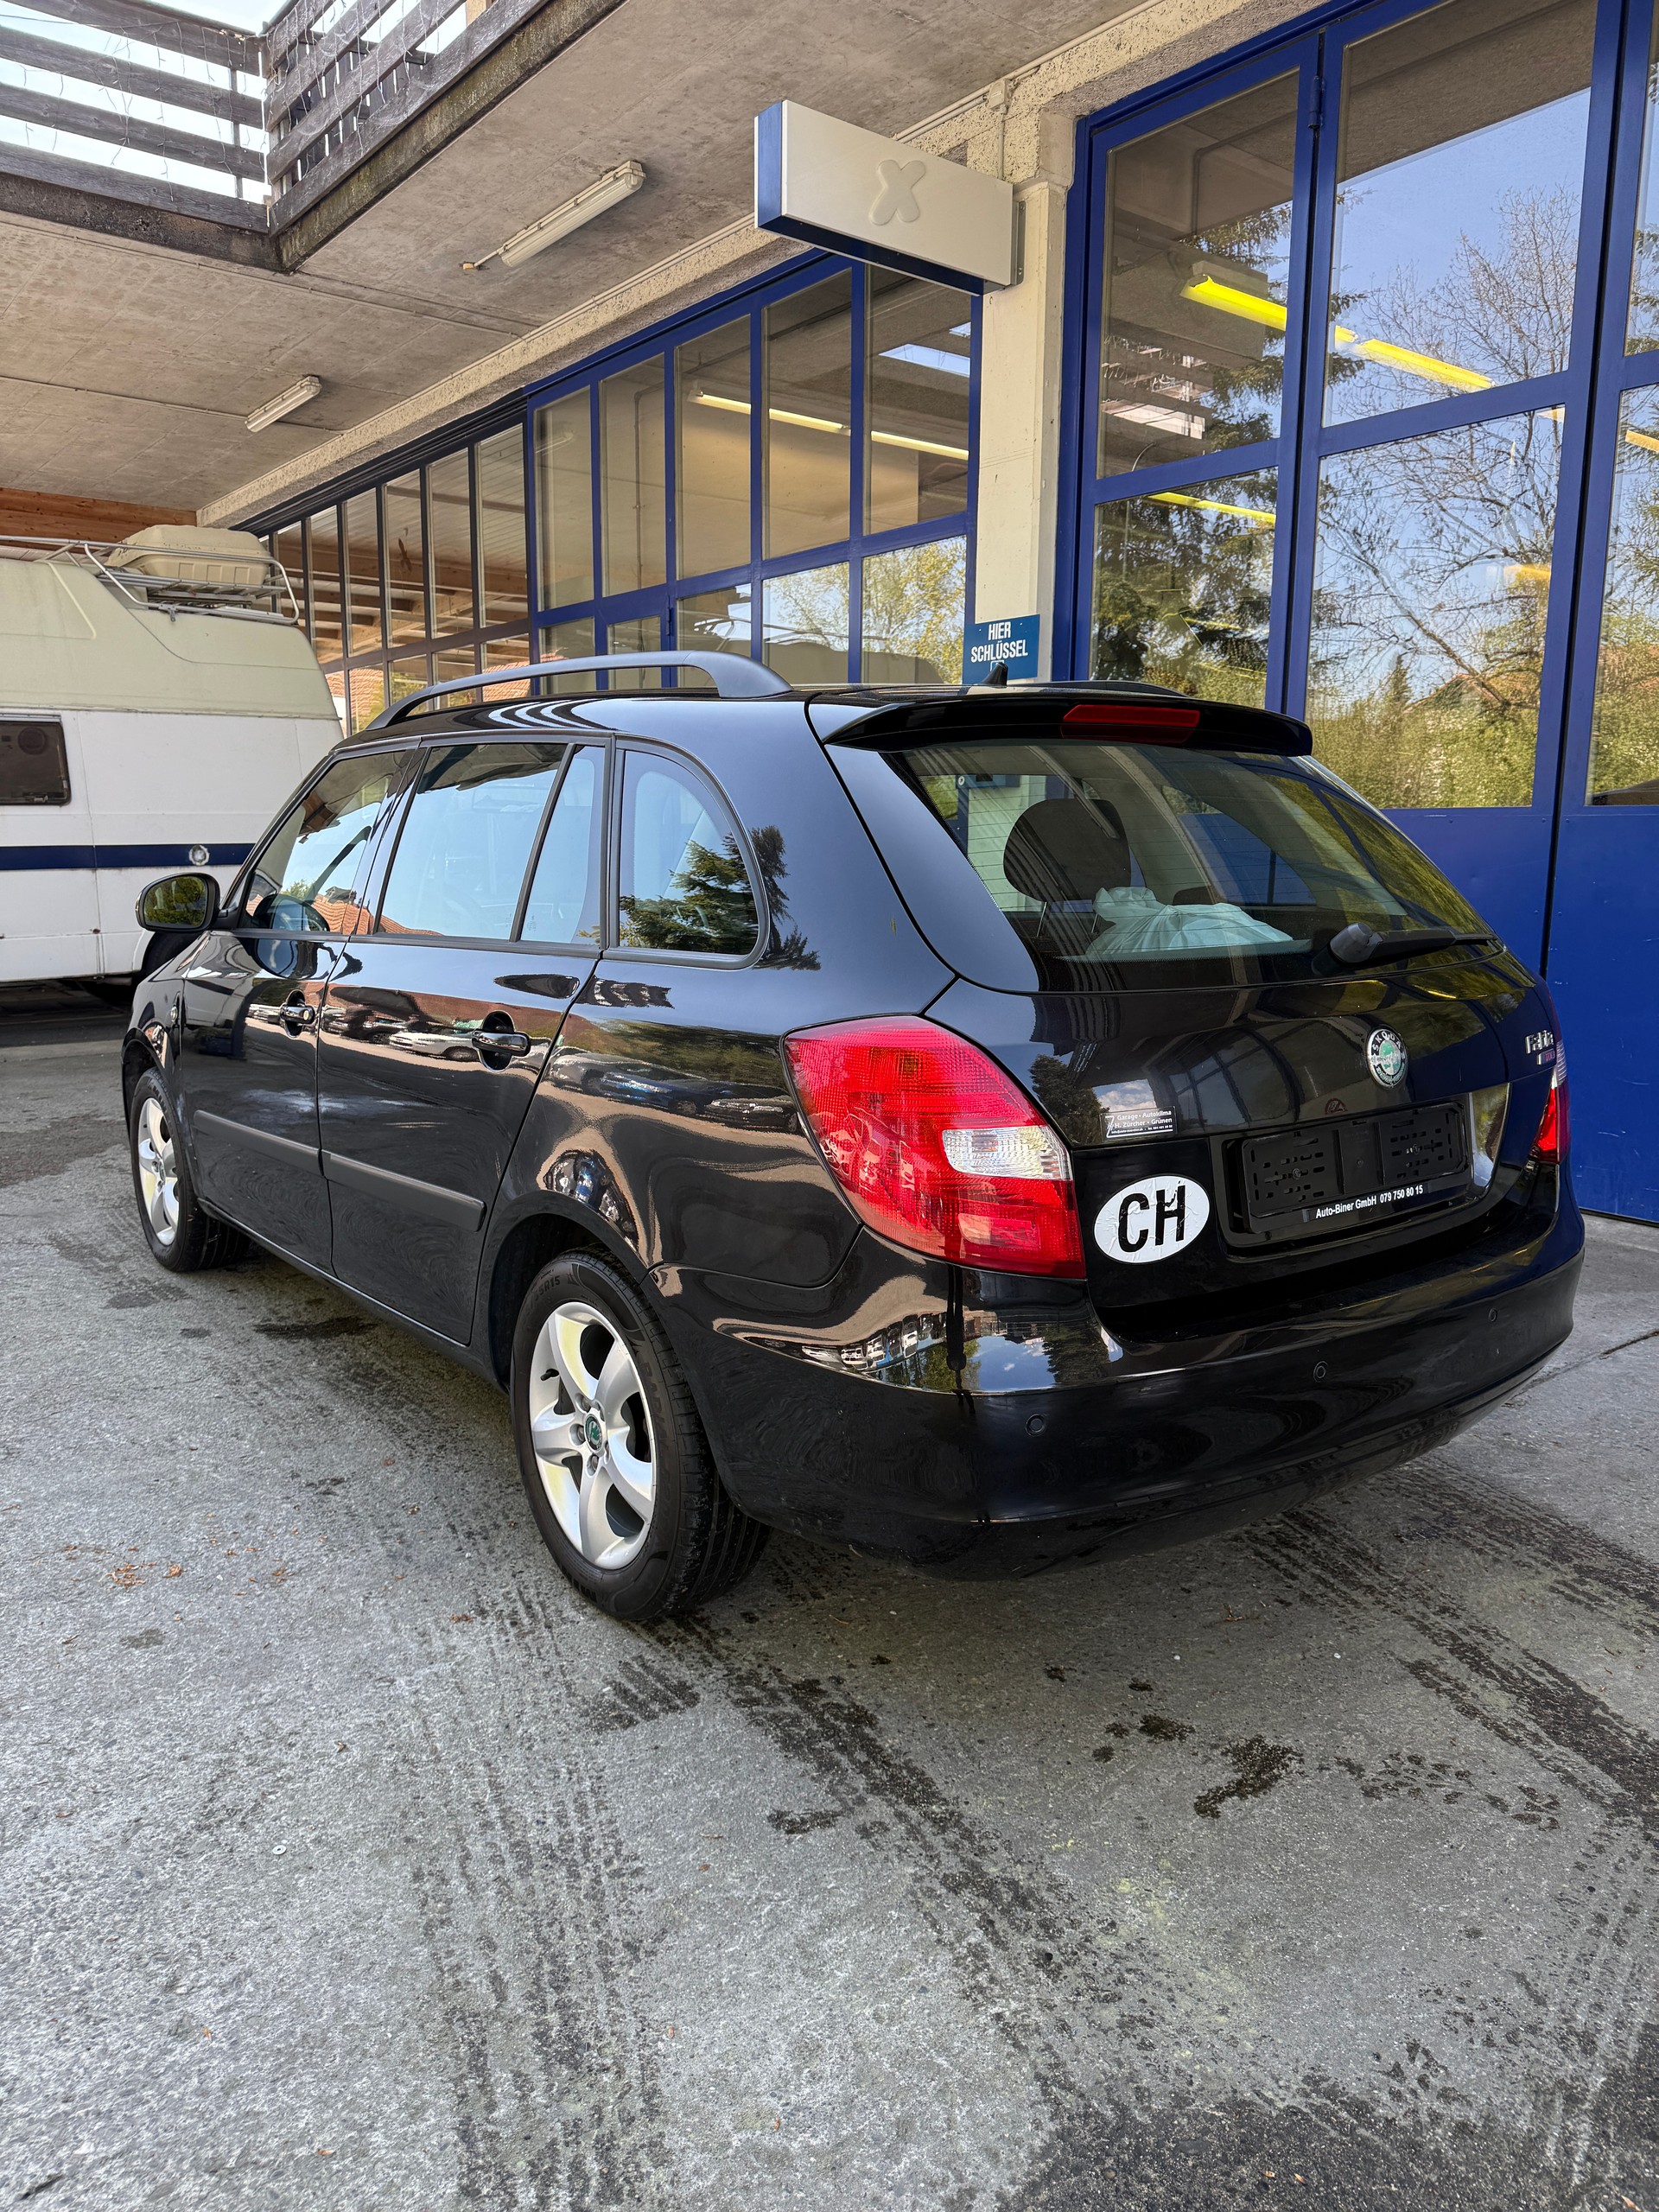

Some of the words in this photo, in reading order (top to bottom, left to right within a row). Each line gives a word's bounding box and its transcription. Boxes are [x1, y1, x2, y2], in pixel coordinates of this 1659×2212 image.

[988, 621, 1012, 641] HIER
[970, 639, 1028, 663] SCHLÜSSEL
[1315, 1202, 1355, 1218] Auto-Biner
[1355, 1195, 1377, 1210] GmbH
[1379, 1192, 1392, 1204] 079
[1393, 1189, 1405, 1200] 750
[1406, 1186, 1414, 1198] 80
[1415, 1185, 1423, 1194] 15
[1117, 1184, 1187, 1253] CH
